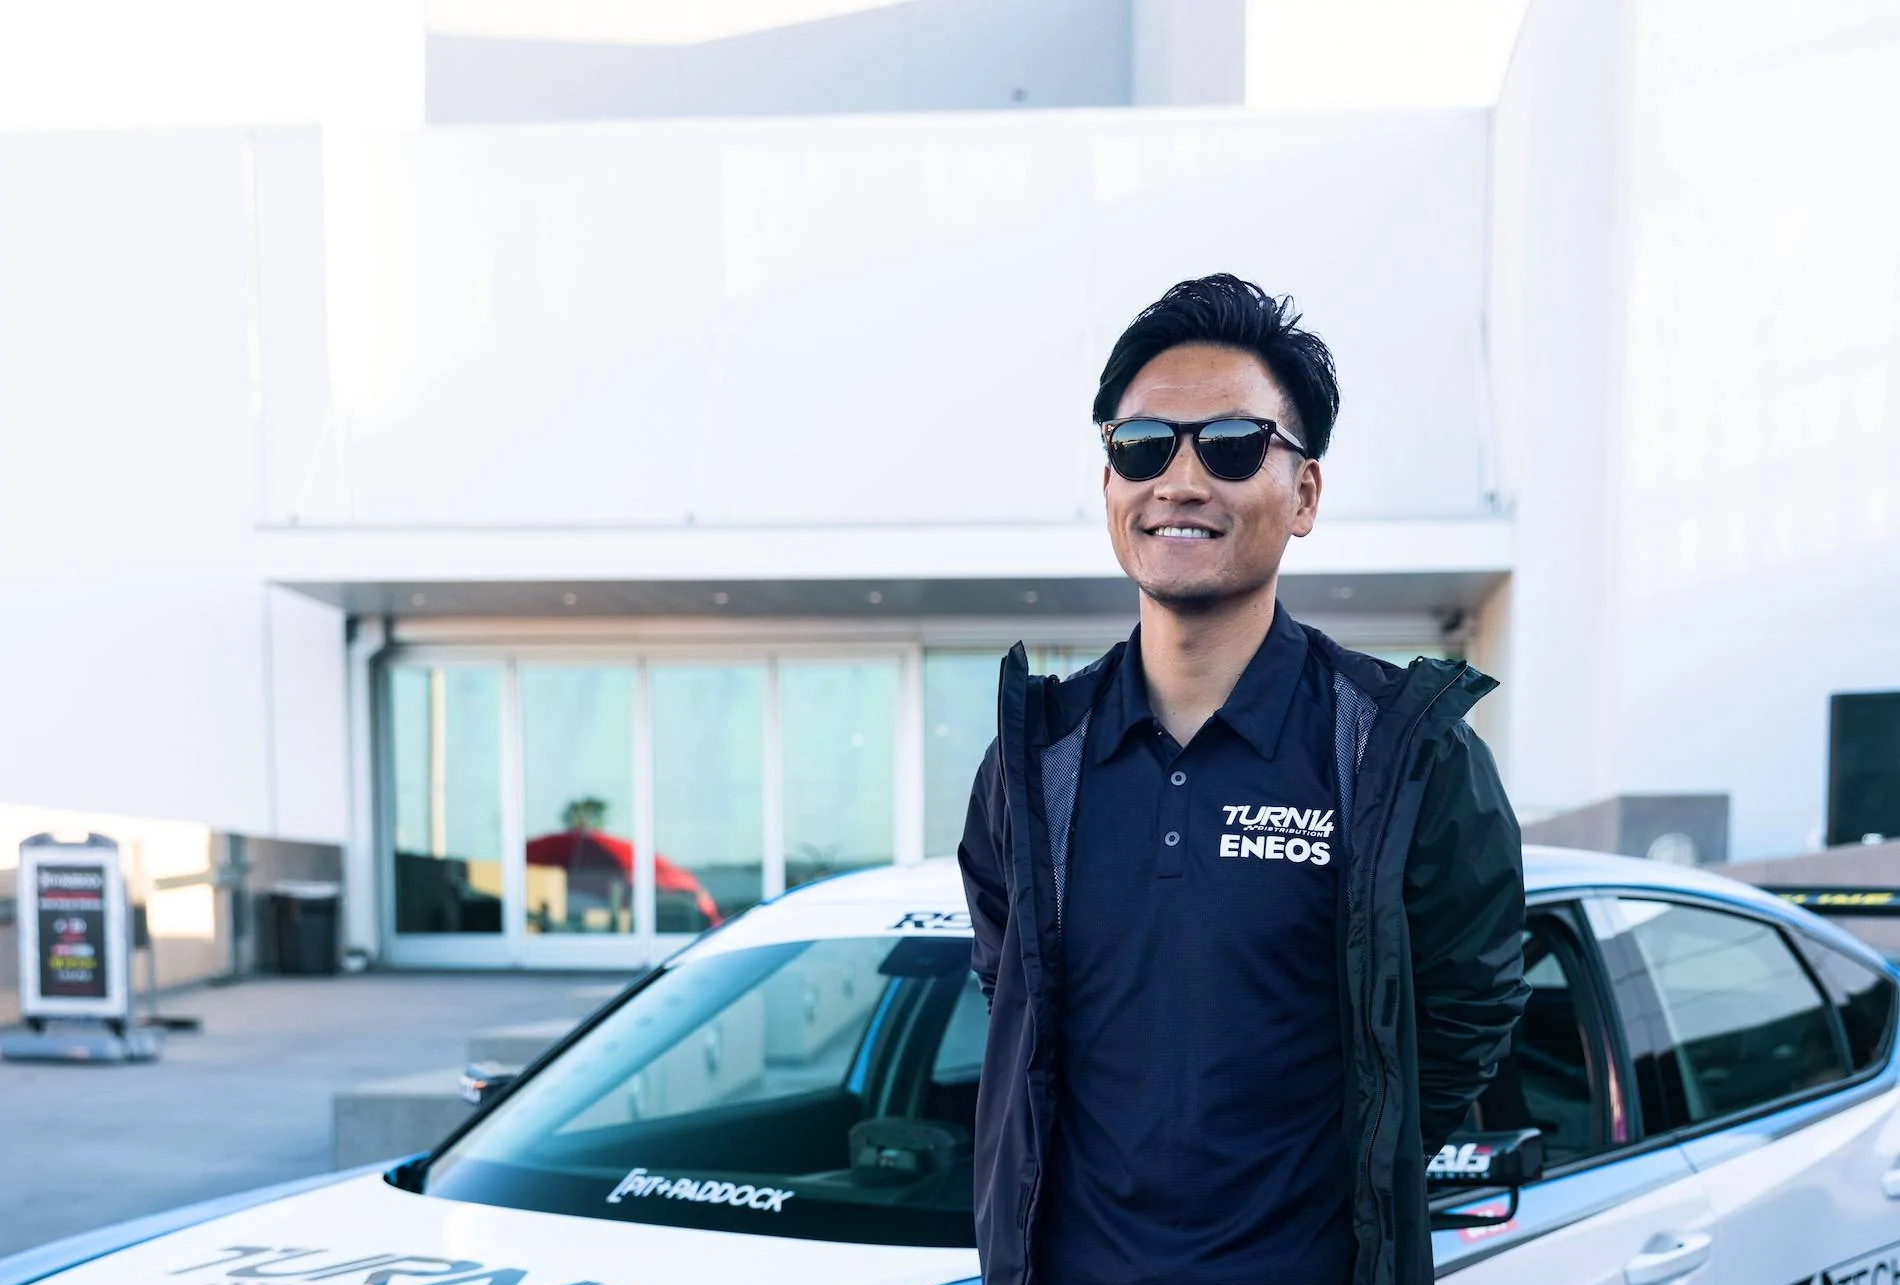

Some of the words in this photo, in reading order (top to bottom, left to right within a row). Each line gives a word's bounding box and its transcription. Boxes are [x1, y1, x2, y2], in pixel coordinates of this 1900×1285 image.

[1222, 805, 1335, 838] TURN14
[1257, 825, 1324, 838] DISTRIBUTION
[1219, 834, 1331, 866] ENEOS
